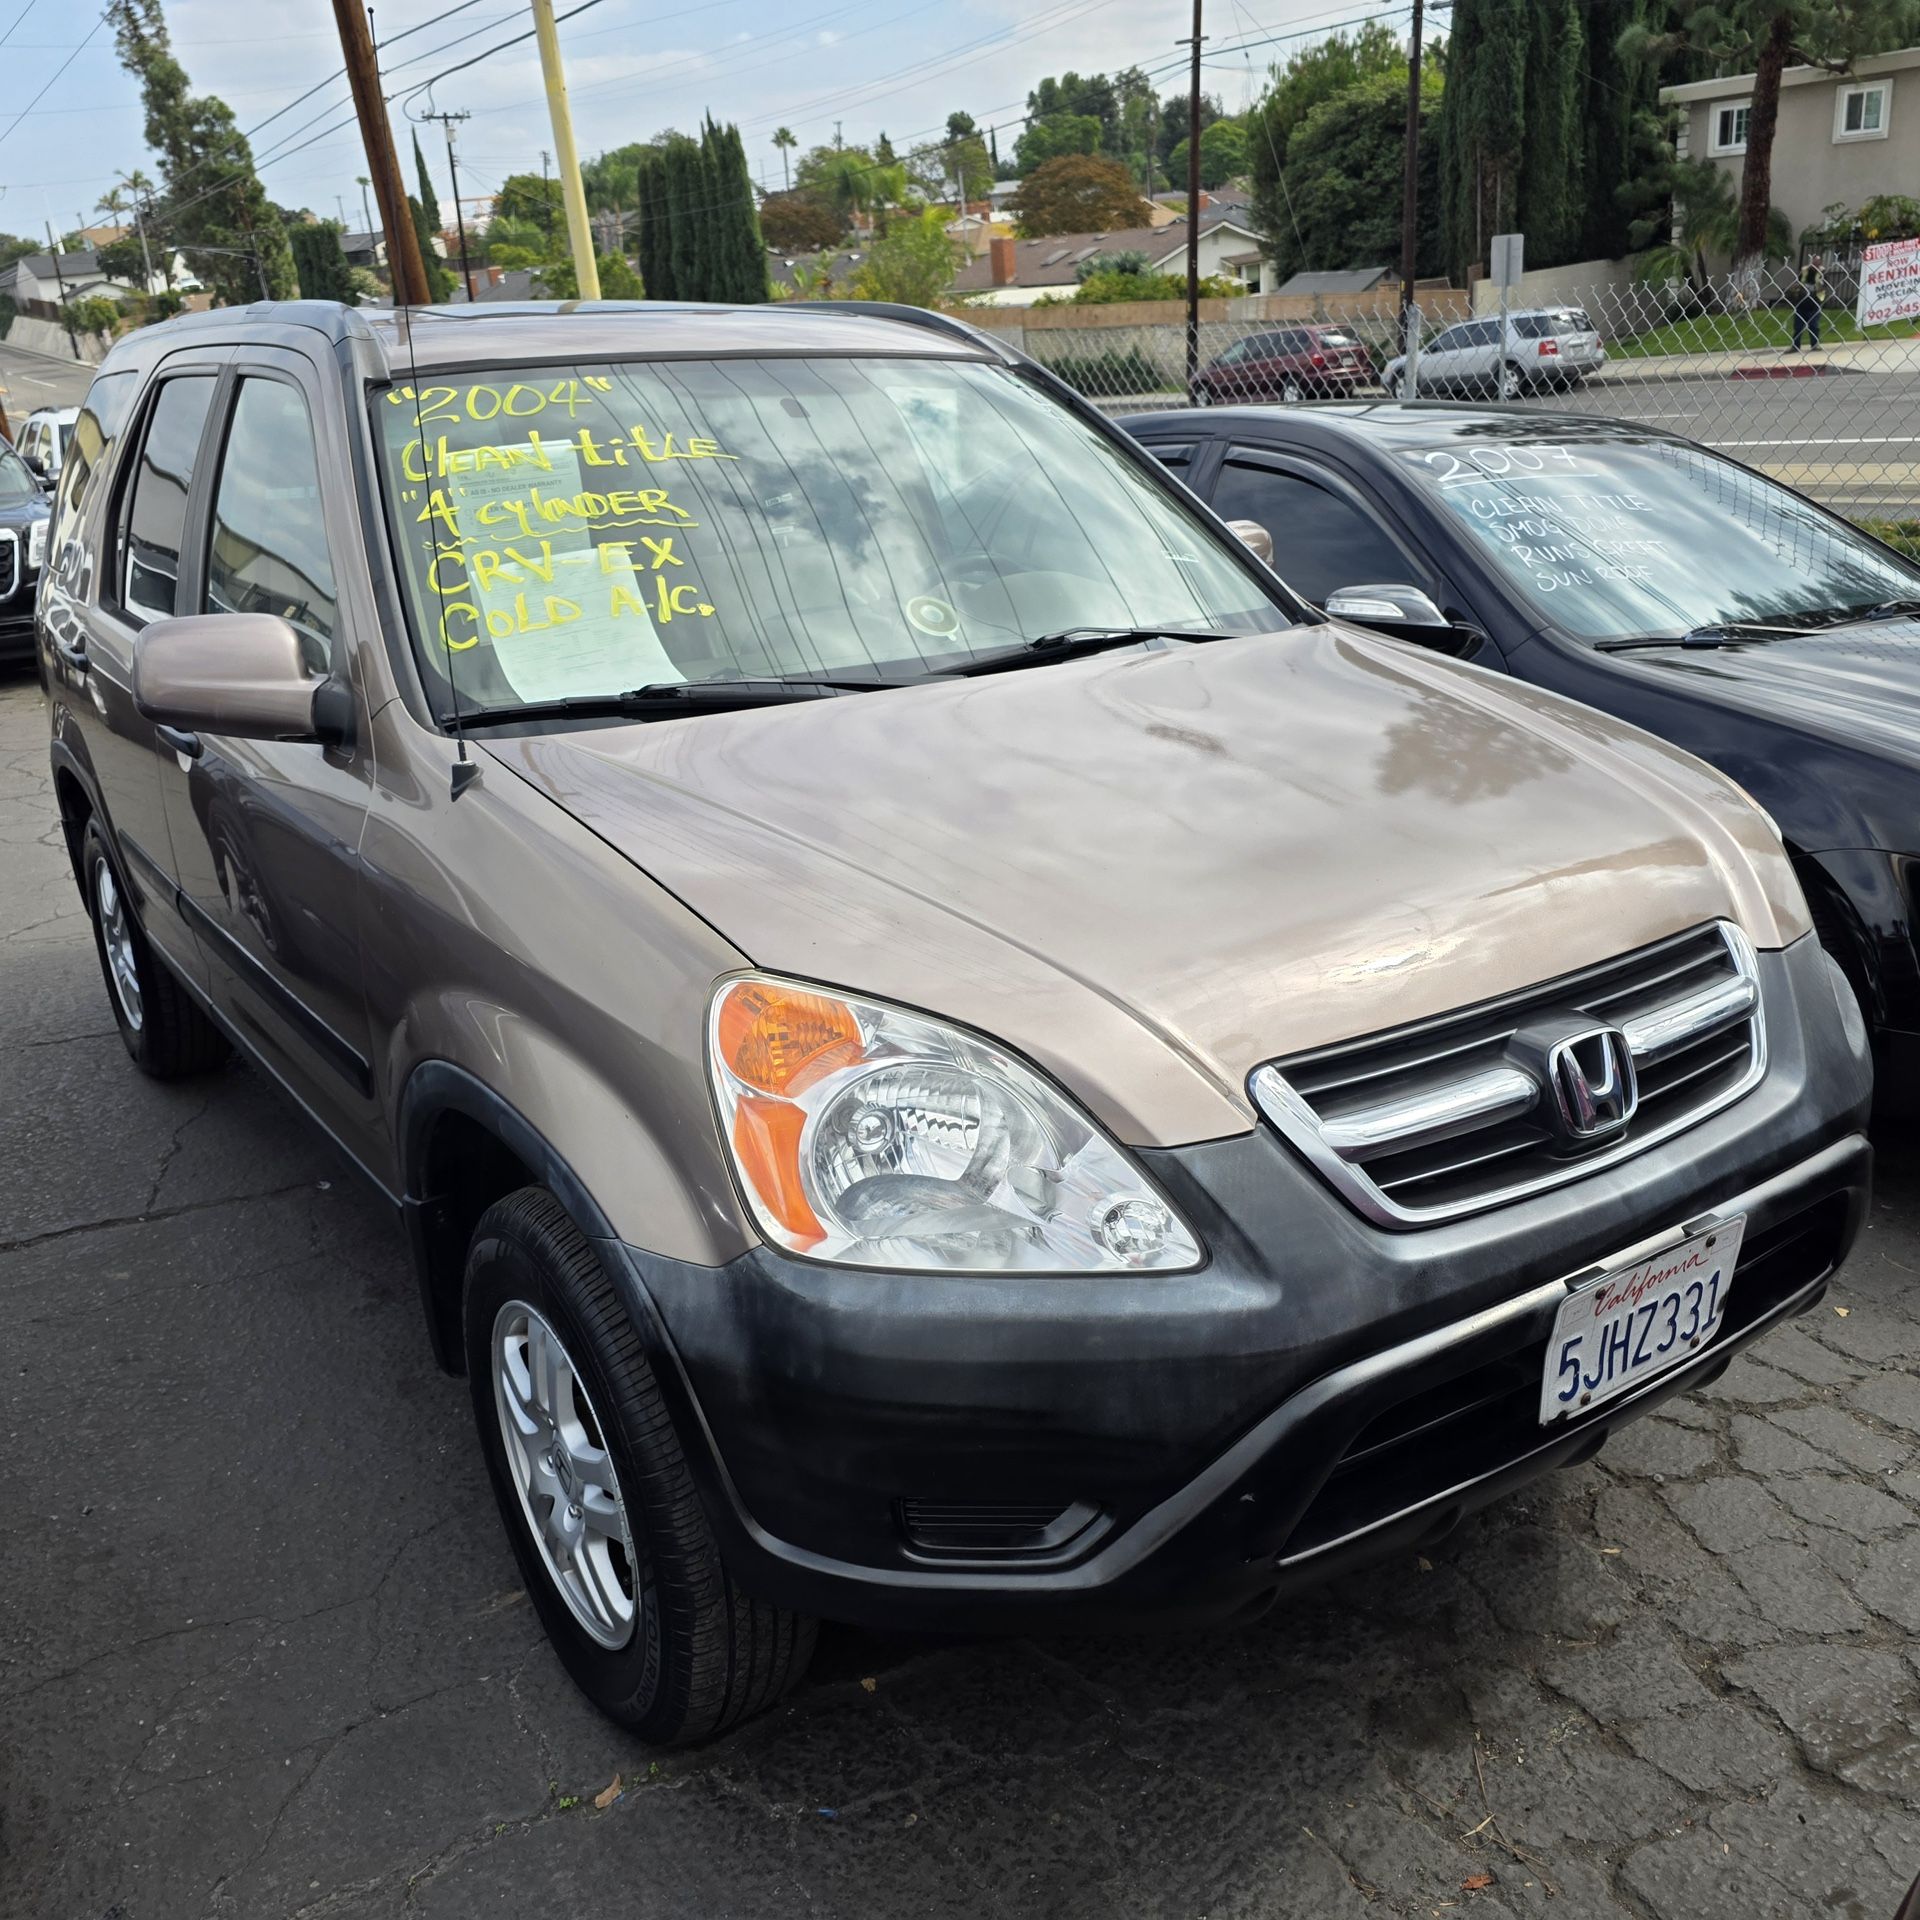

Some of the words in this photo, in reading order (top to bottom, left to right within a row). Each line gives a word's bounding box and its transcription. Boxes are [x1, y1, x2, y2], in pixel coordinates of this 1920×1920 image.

[1868, 264, 1920, 285] RENTIN
[1868, 308, 1892, 321] 902
[1424, 445, 1577, 483] 2007
[1472, 494, 1564, 519] CLEAN
[1561, 493, 1653, 512] TITLE
[1489, 518, 1566, 544] SMOG
[1565, 515, 1634, 535] DONE
[427, 540, 554, 594] CRV
[597, 537, 685, 575] EX
[1511, 542, 1591, 569] RUNS
[1592, 539, 1669, 559] GREAT
[1535, 568, 1593, 592] SUN
[1594, 565, 1655, 581] ROOF
[438, 591, 583, 653] COLD
[1594, 1249, 1709, 1317] California
[1558, 1270, 1721, 1402] 5JHZ331
